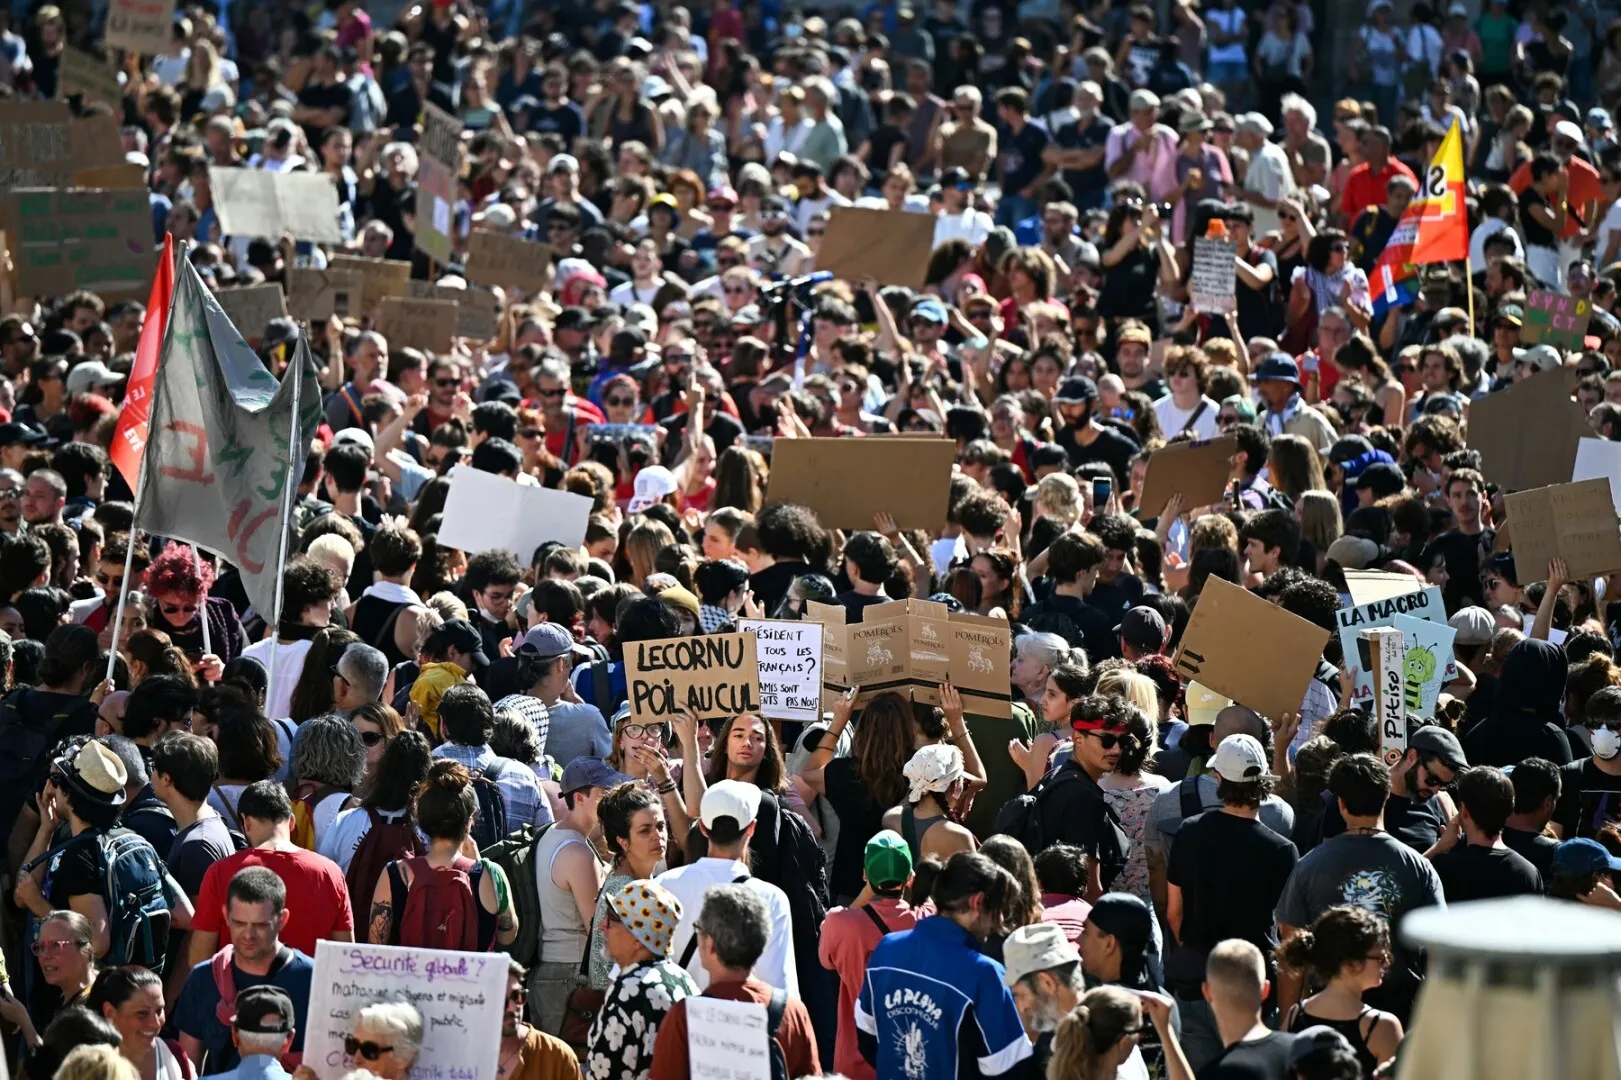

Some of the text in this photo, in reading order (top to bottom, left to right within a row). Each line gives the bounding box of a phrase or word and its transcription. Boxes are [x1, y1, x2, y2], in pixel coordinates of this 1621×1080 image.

[1340, 591, 1429, 627] LA MACRO
[853, 626, 903, 640] POMEROLS
[955, 631, 1005, 647] POMEROLS
[637, 637, 744, 671] LECORNU
[764, 646, 812, 656] TOUS LES
[780, 684, 800, 693] SONT
[1353, 684, 1372, 699] LA
[687, 683, 713, 712] AU
[715, 682, 760, 715] CUL
[786, 696, 799, 707] PAS
[801, 696, 819, 709] NOUS
[1383, 670, 1403, 739] Pitiso
[885, 988, 942, 1020] LA PLAYA
